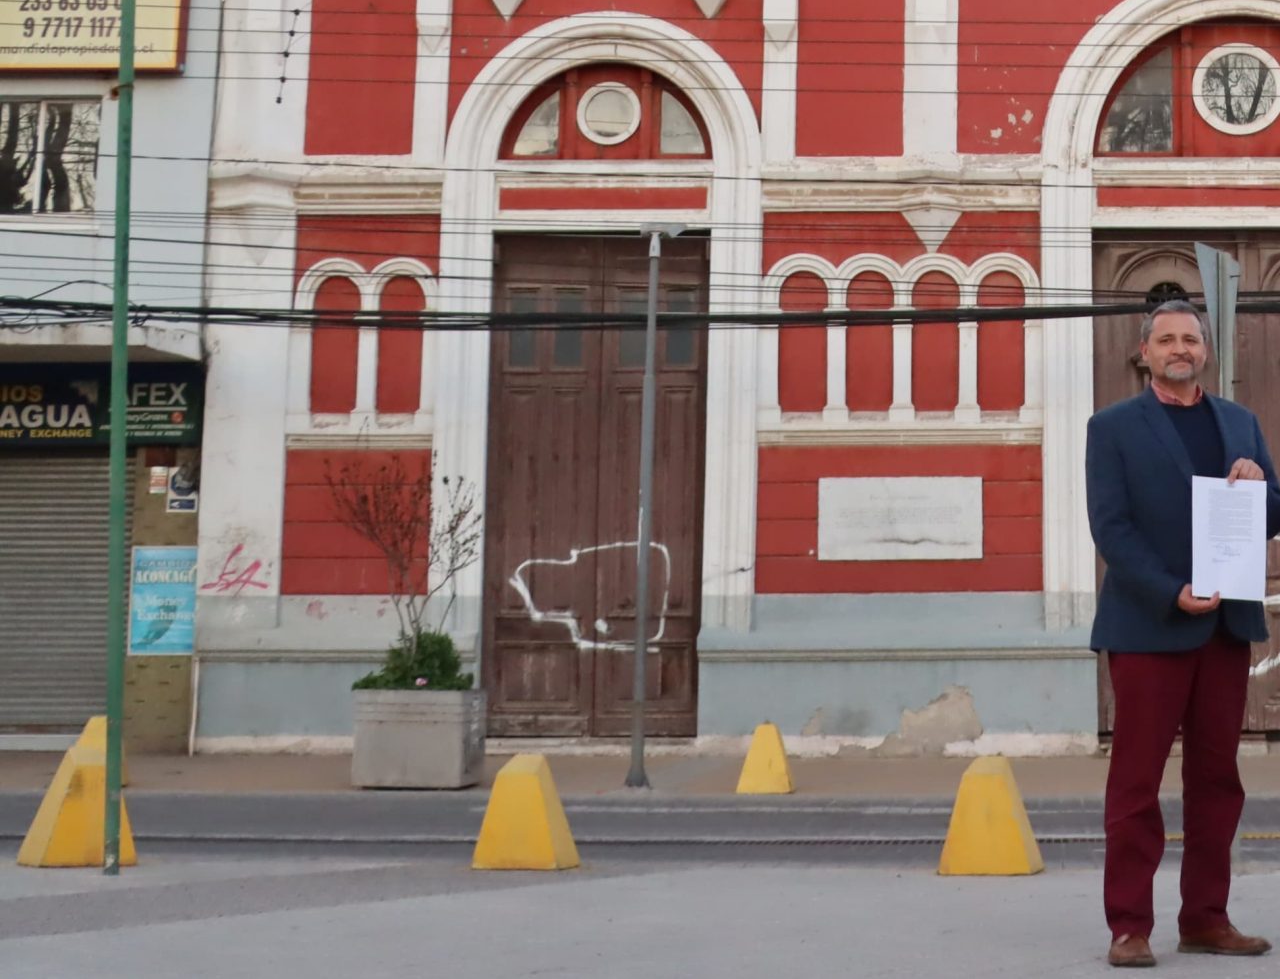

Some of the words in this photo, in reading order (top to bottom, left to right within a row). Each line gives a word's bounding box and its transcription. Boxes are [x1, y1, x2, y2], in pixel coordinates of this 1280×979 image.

[23, 17, 36, 38] 9
[41, 17, 84, 38] 7717
[0, 385, 43, 403] IOS
[0, 404, 93, 428] AGUA
[30, 429, 93, 438] EXCHANGE
